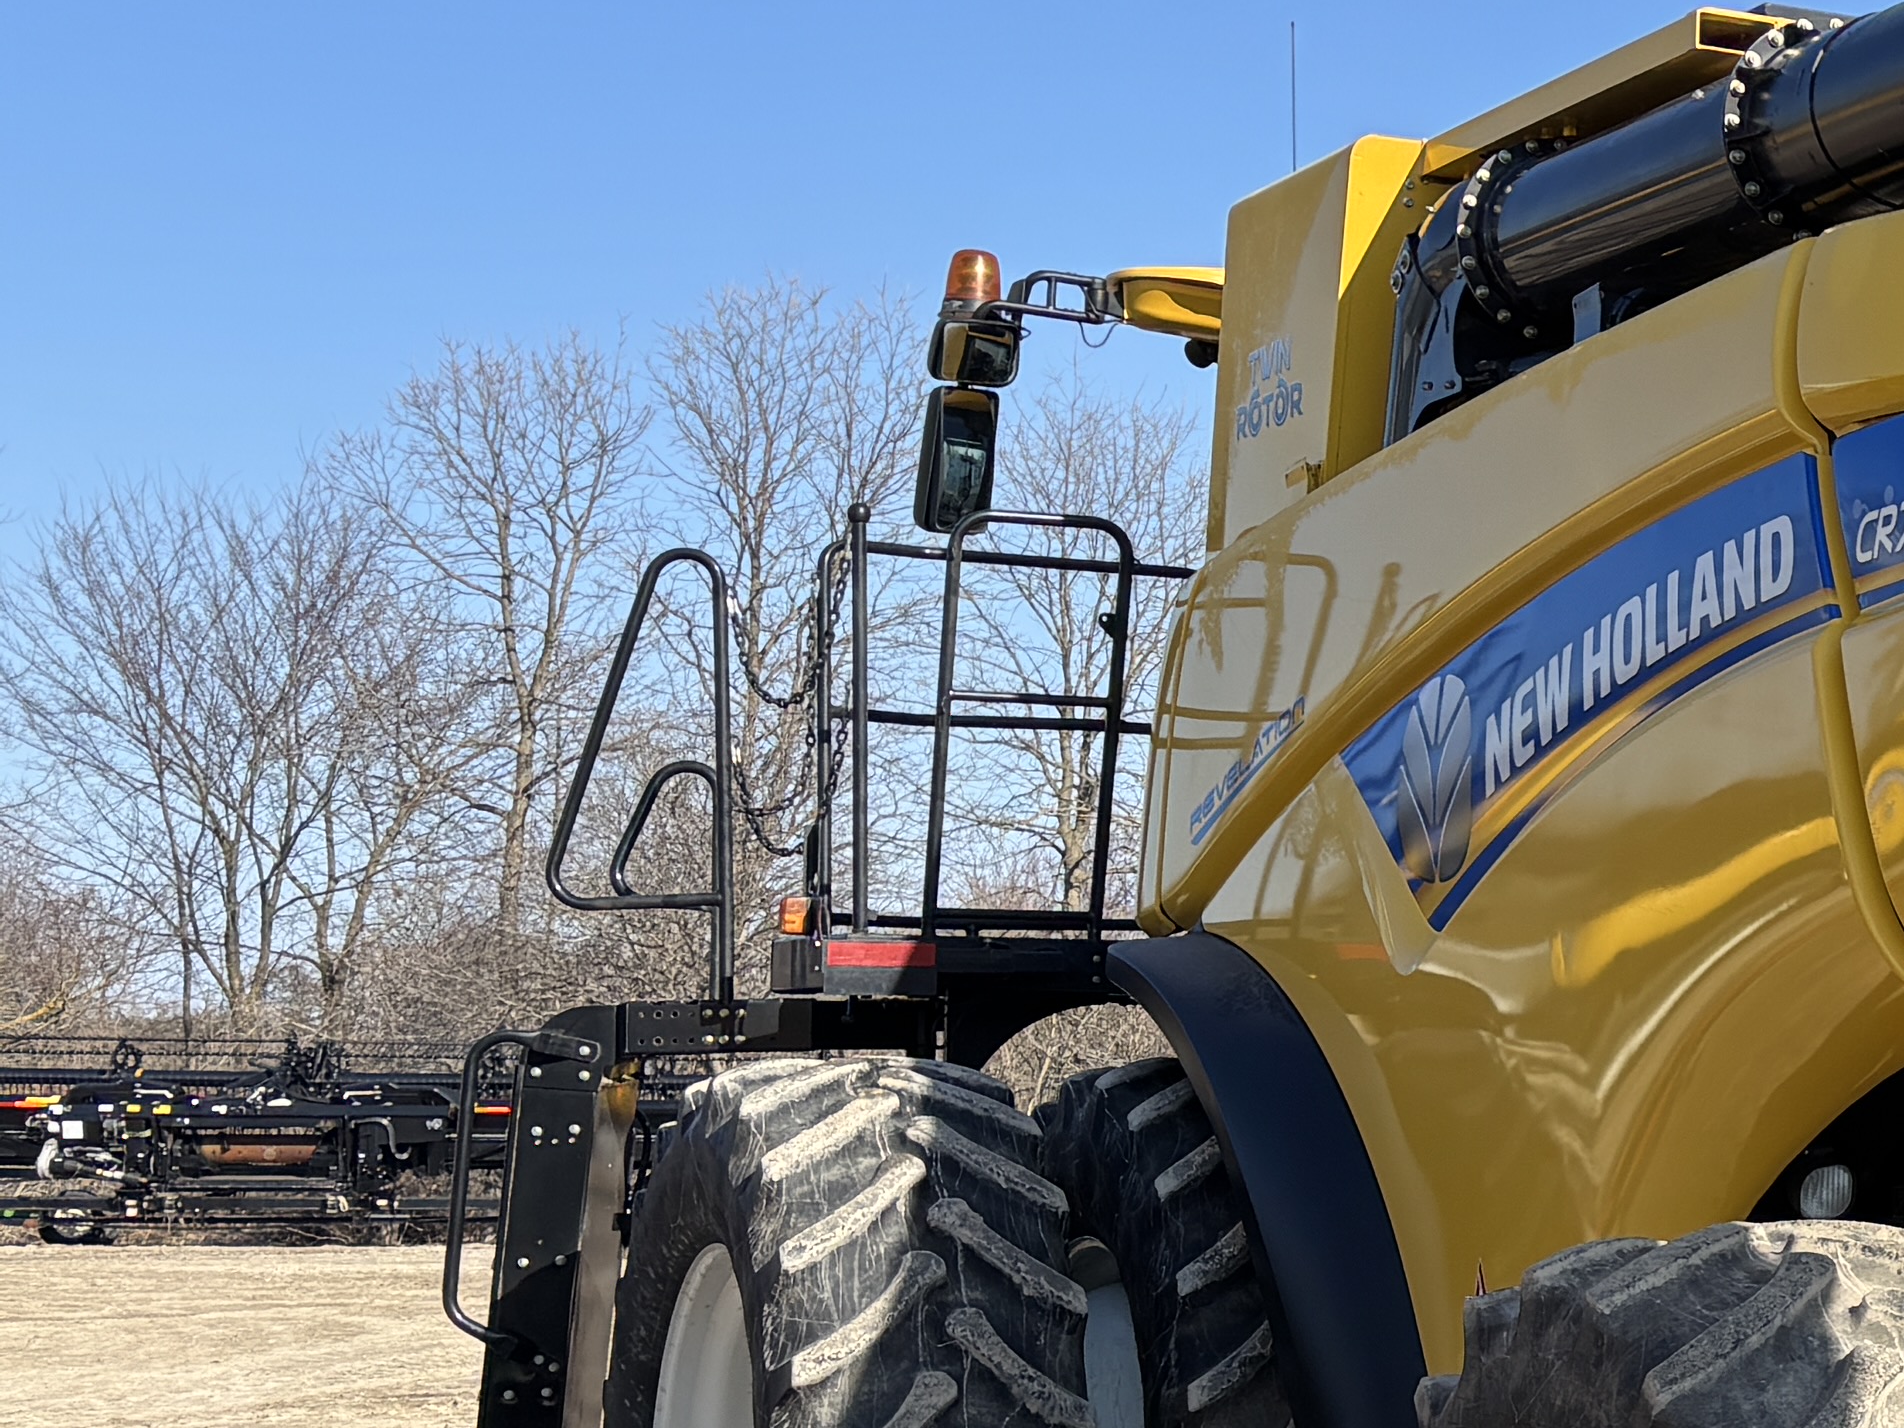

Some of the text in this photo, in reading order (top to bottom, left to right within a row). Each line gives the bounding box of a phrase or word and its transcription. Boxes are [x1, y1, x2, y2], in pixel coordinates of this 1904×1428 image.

[1236, 376, 1303, 441] ROTOR
[1248, 336, 1292, 386] TWIN
[1485, 514, 1795, 799] NEW HOLLAND
[1189, 695, 1305, 835] REVELATION
